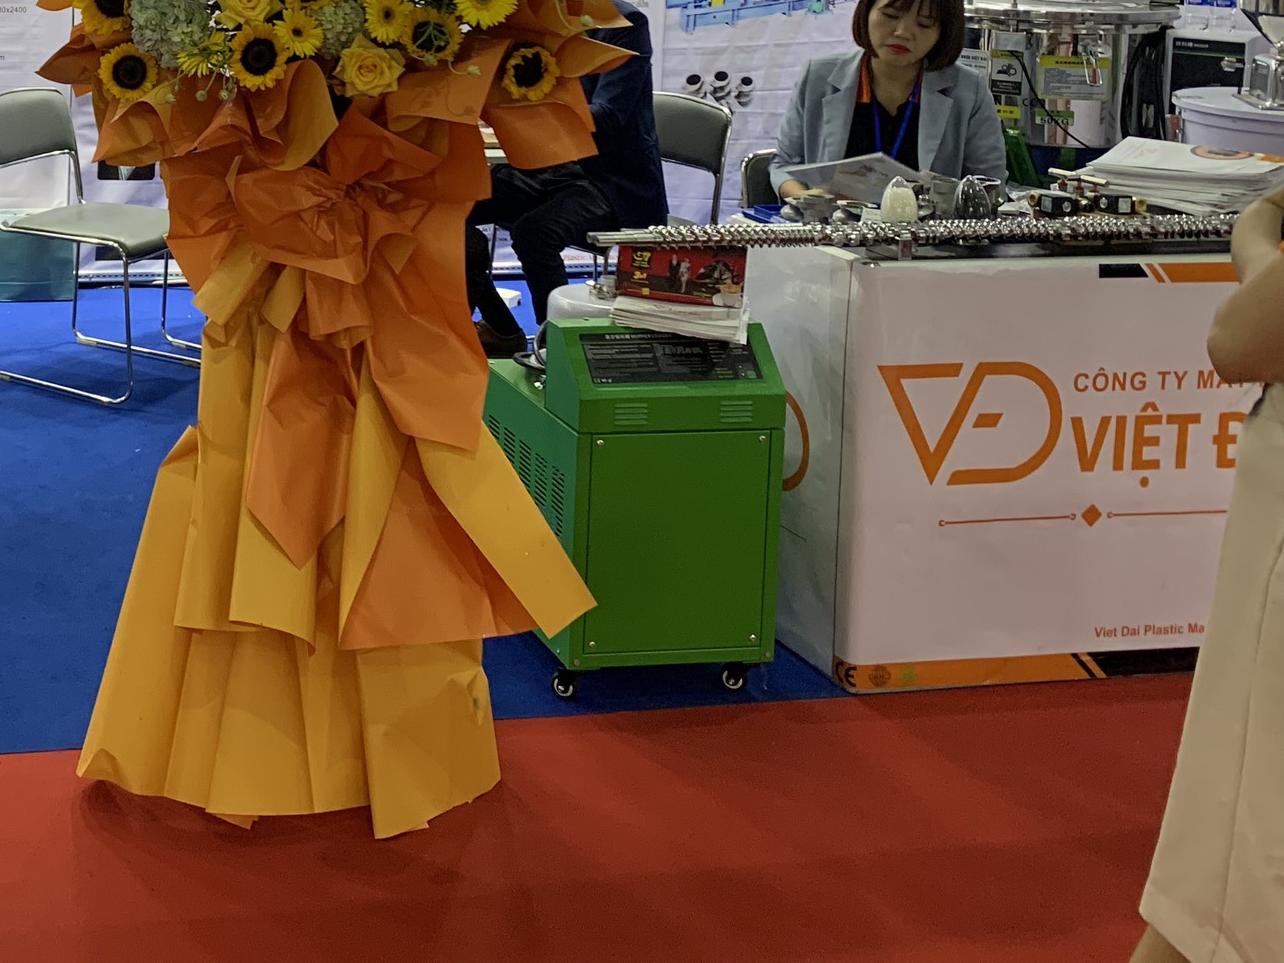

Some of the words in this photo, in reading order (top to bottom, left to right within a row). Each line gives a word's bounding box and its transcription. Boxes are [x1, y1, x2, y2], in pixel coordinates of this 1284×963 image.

[1073, 367, 1147, 393] CÔNG
[1157, 371, 1188, 390] TY
[1070, 401, 1201, 488] VIỆT
[1095, 626, 1118, 638] Viet
[1121, 625, 1141, 637] Dai
[1144, 623, 1185, 636] Plastic
